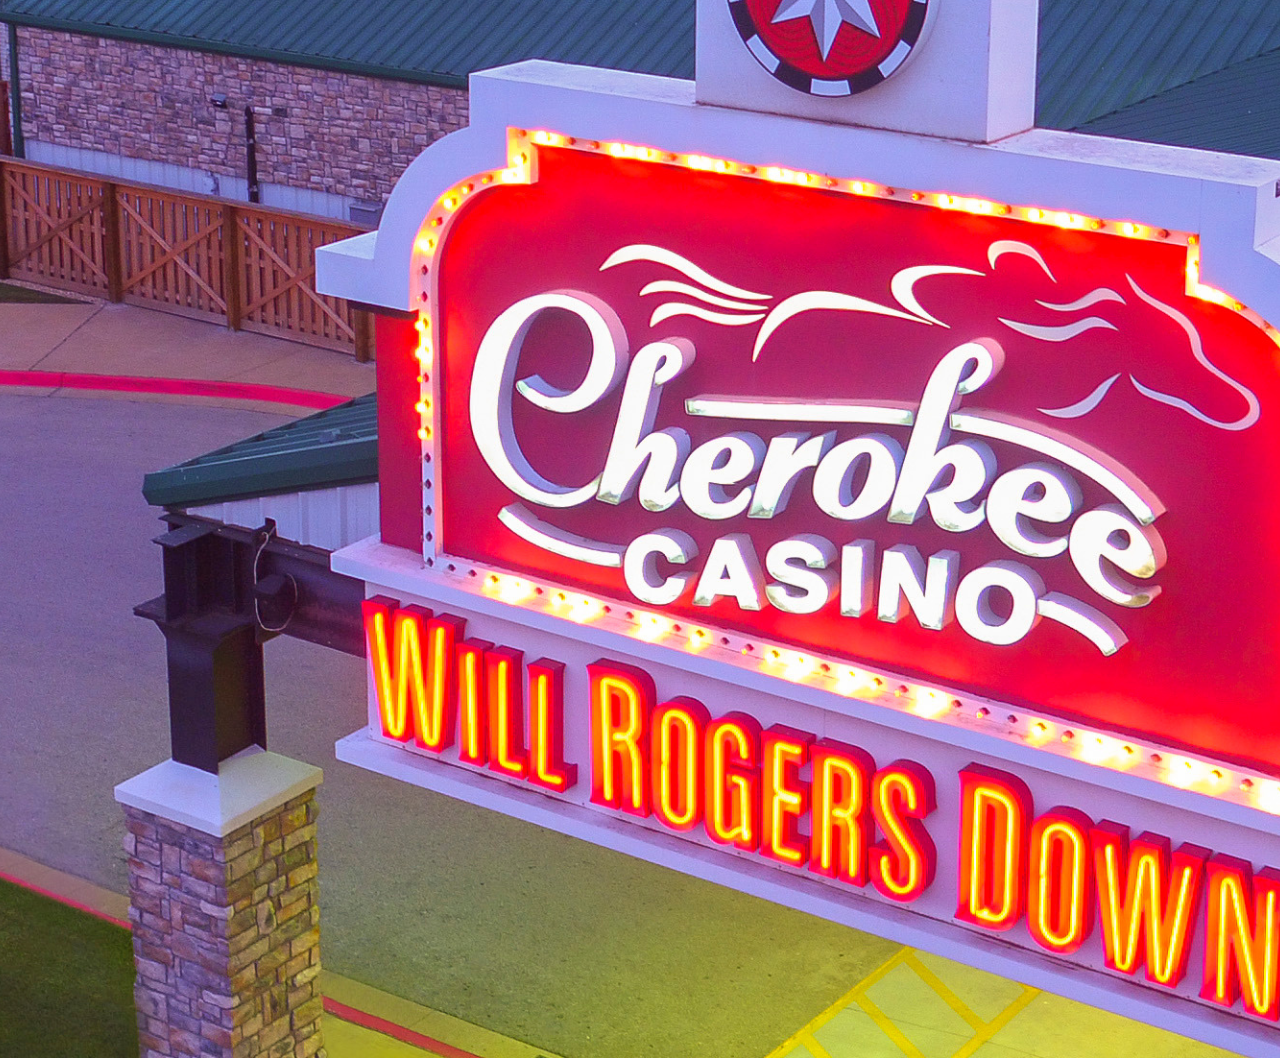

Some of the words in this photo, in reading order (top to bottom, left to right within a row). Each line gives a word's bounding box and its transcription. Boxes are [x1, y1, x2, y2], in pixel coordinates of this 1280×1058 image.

[470, 288, 1164, 609] Cherokee
[623, 526, 1046, 646] CASINO
[362, 594, 578, 793] WILL
[586, 657, 937, 903] ROGERS
